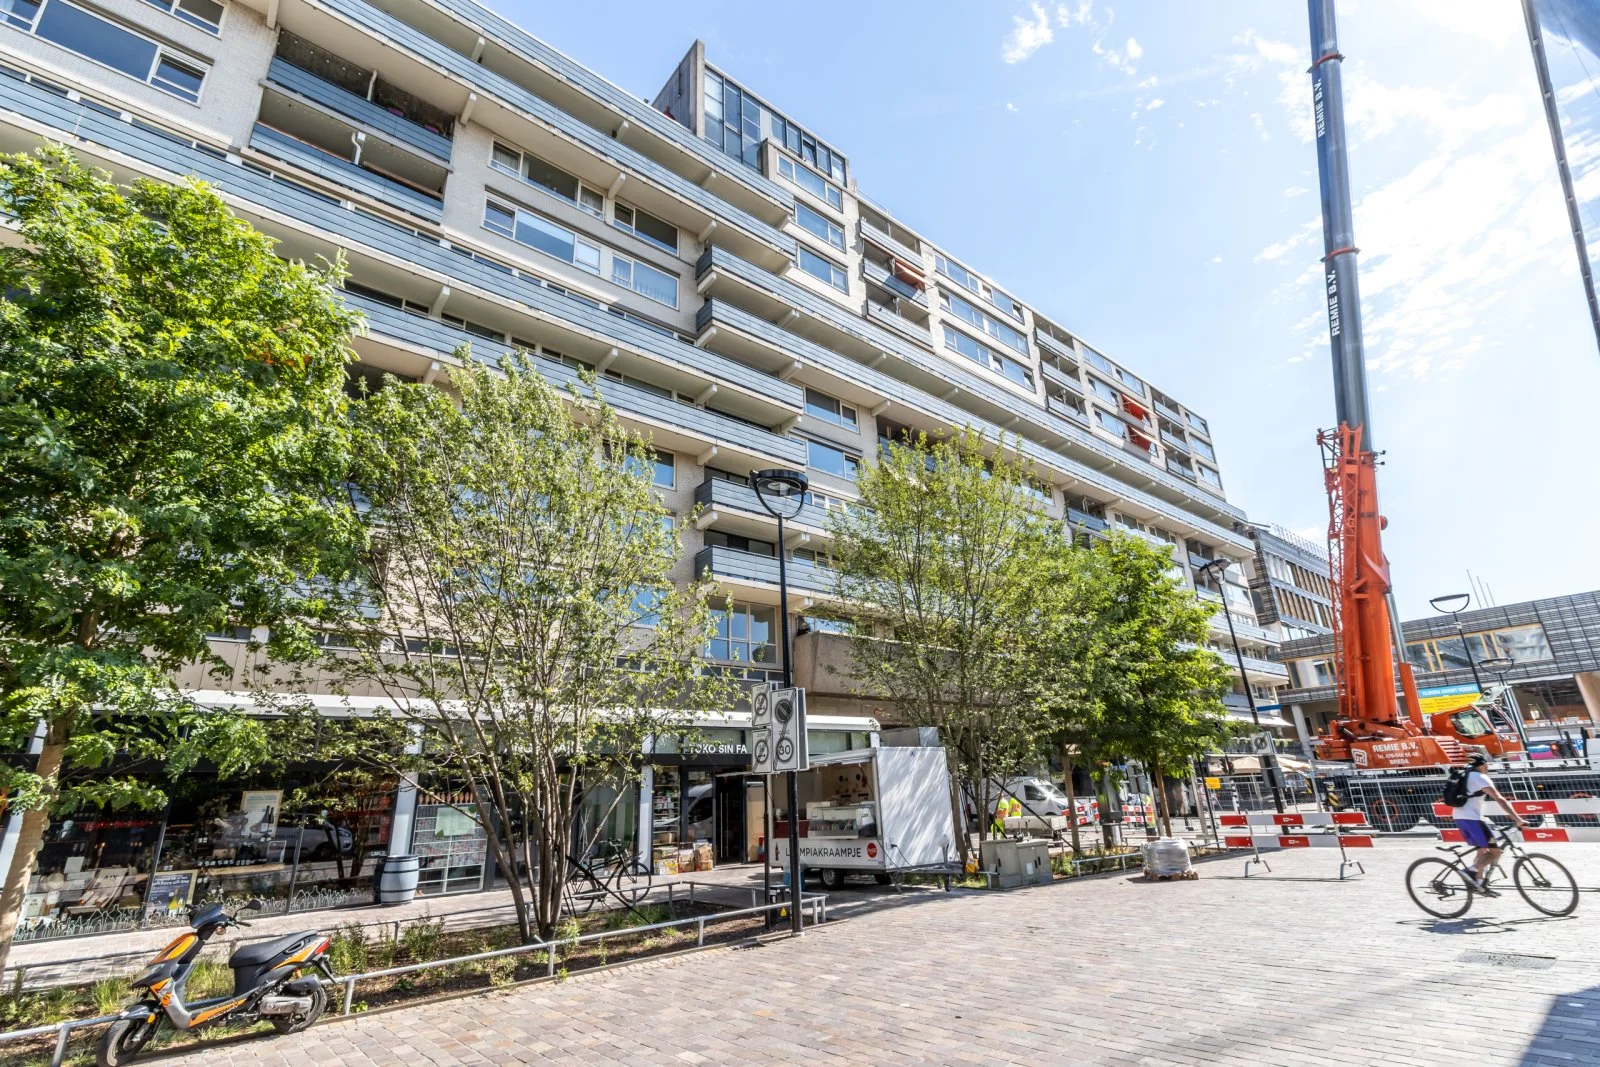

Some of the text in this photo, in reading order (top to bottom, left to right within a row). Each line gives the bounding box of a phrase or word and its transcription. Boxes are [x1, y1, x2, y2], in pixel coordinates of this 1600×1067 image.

[1314, 78, 1325, 138] REMIE B.V.
[1327, 269, 1340, 337] REMIE B.V.
[689, 743, 748, 754] TOKO SIN FA
[778, 744, 791, 756] 30
[1372, 741, 1419, 753] REMIE B.V.
[785, 847, 862, 858] LMPIAKRAAMPJE
